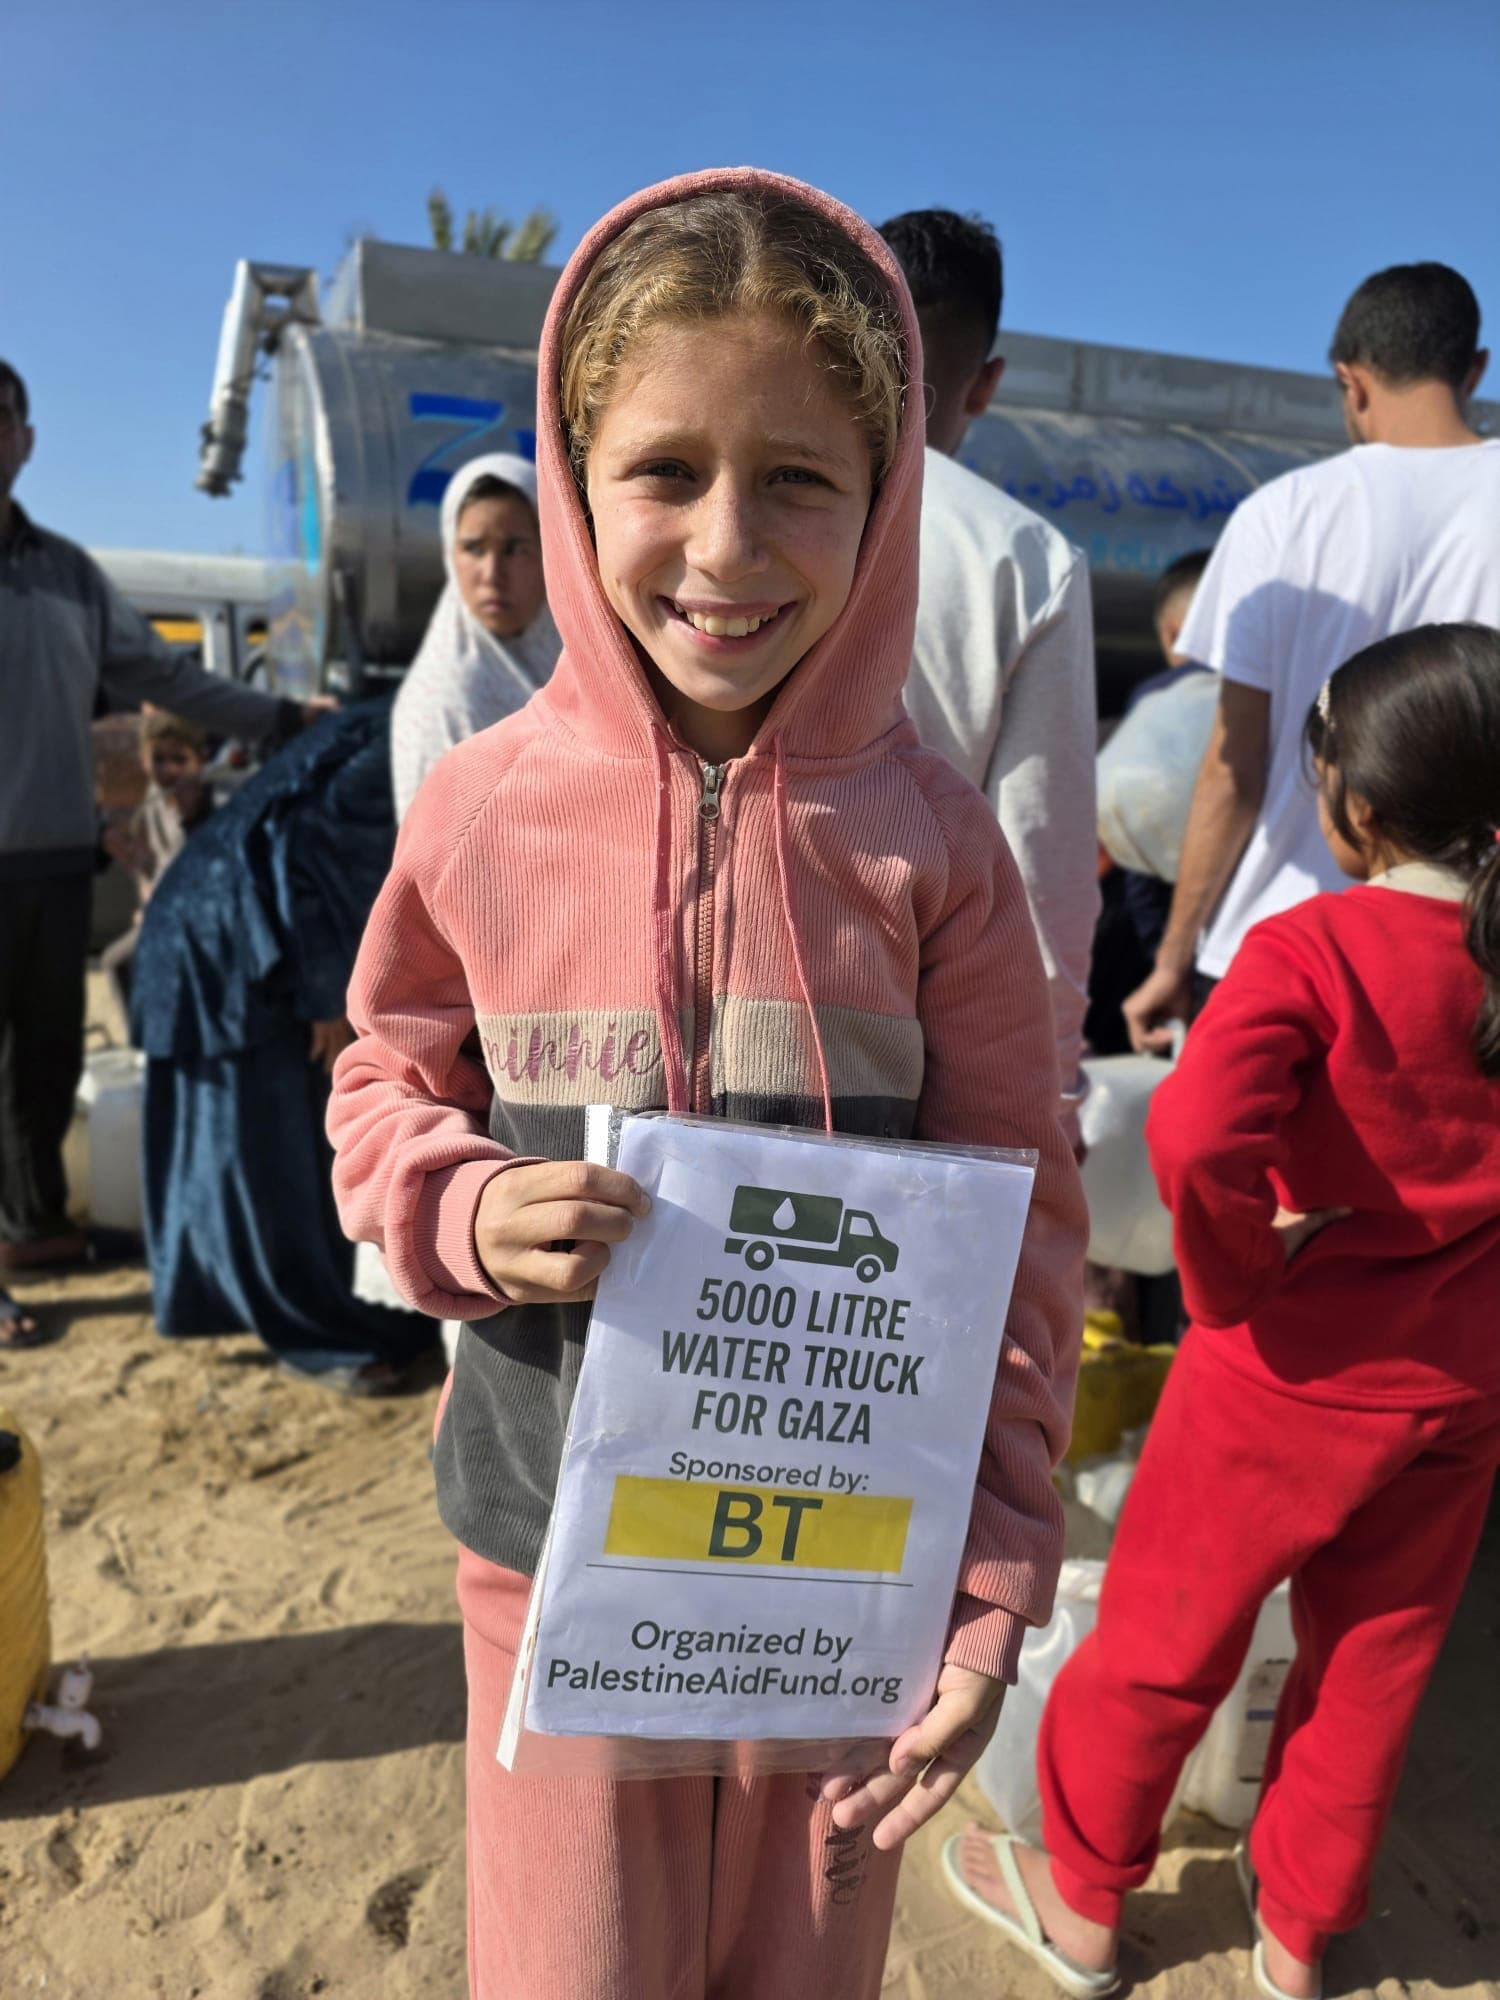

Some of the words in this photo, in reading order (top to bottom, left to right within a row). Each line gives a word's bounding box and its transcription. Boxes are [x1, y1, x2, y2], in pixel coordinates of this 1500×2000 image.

[696, 1277, 797, 1329] 5000
[805, 1290, 912, 1342] LITRE
[662, 1329, 791, 1385] WATER
[804, 1344, 925, 1396] TRUCK
[691, 1389, 768, 1437] FOR
[777, 1397, 871, 1445] GAZA
[668, 1451, 823, 1489] Sponsored
[828, 1465, 870, 1496] by:
[707, 1490, 824, 1562] BT
[631, 1620, 806, 1661] Organized
[812, 1628, 854, 1664] by
[547, 1653, 903, 1705] PalestineAidFund.org
